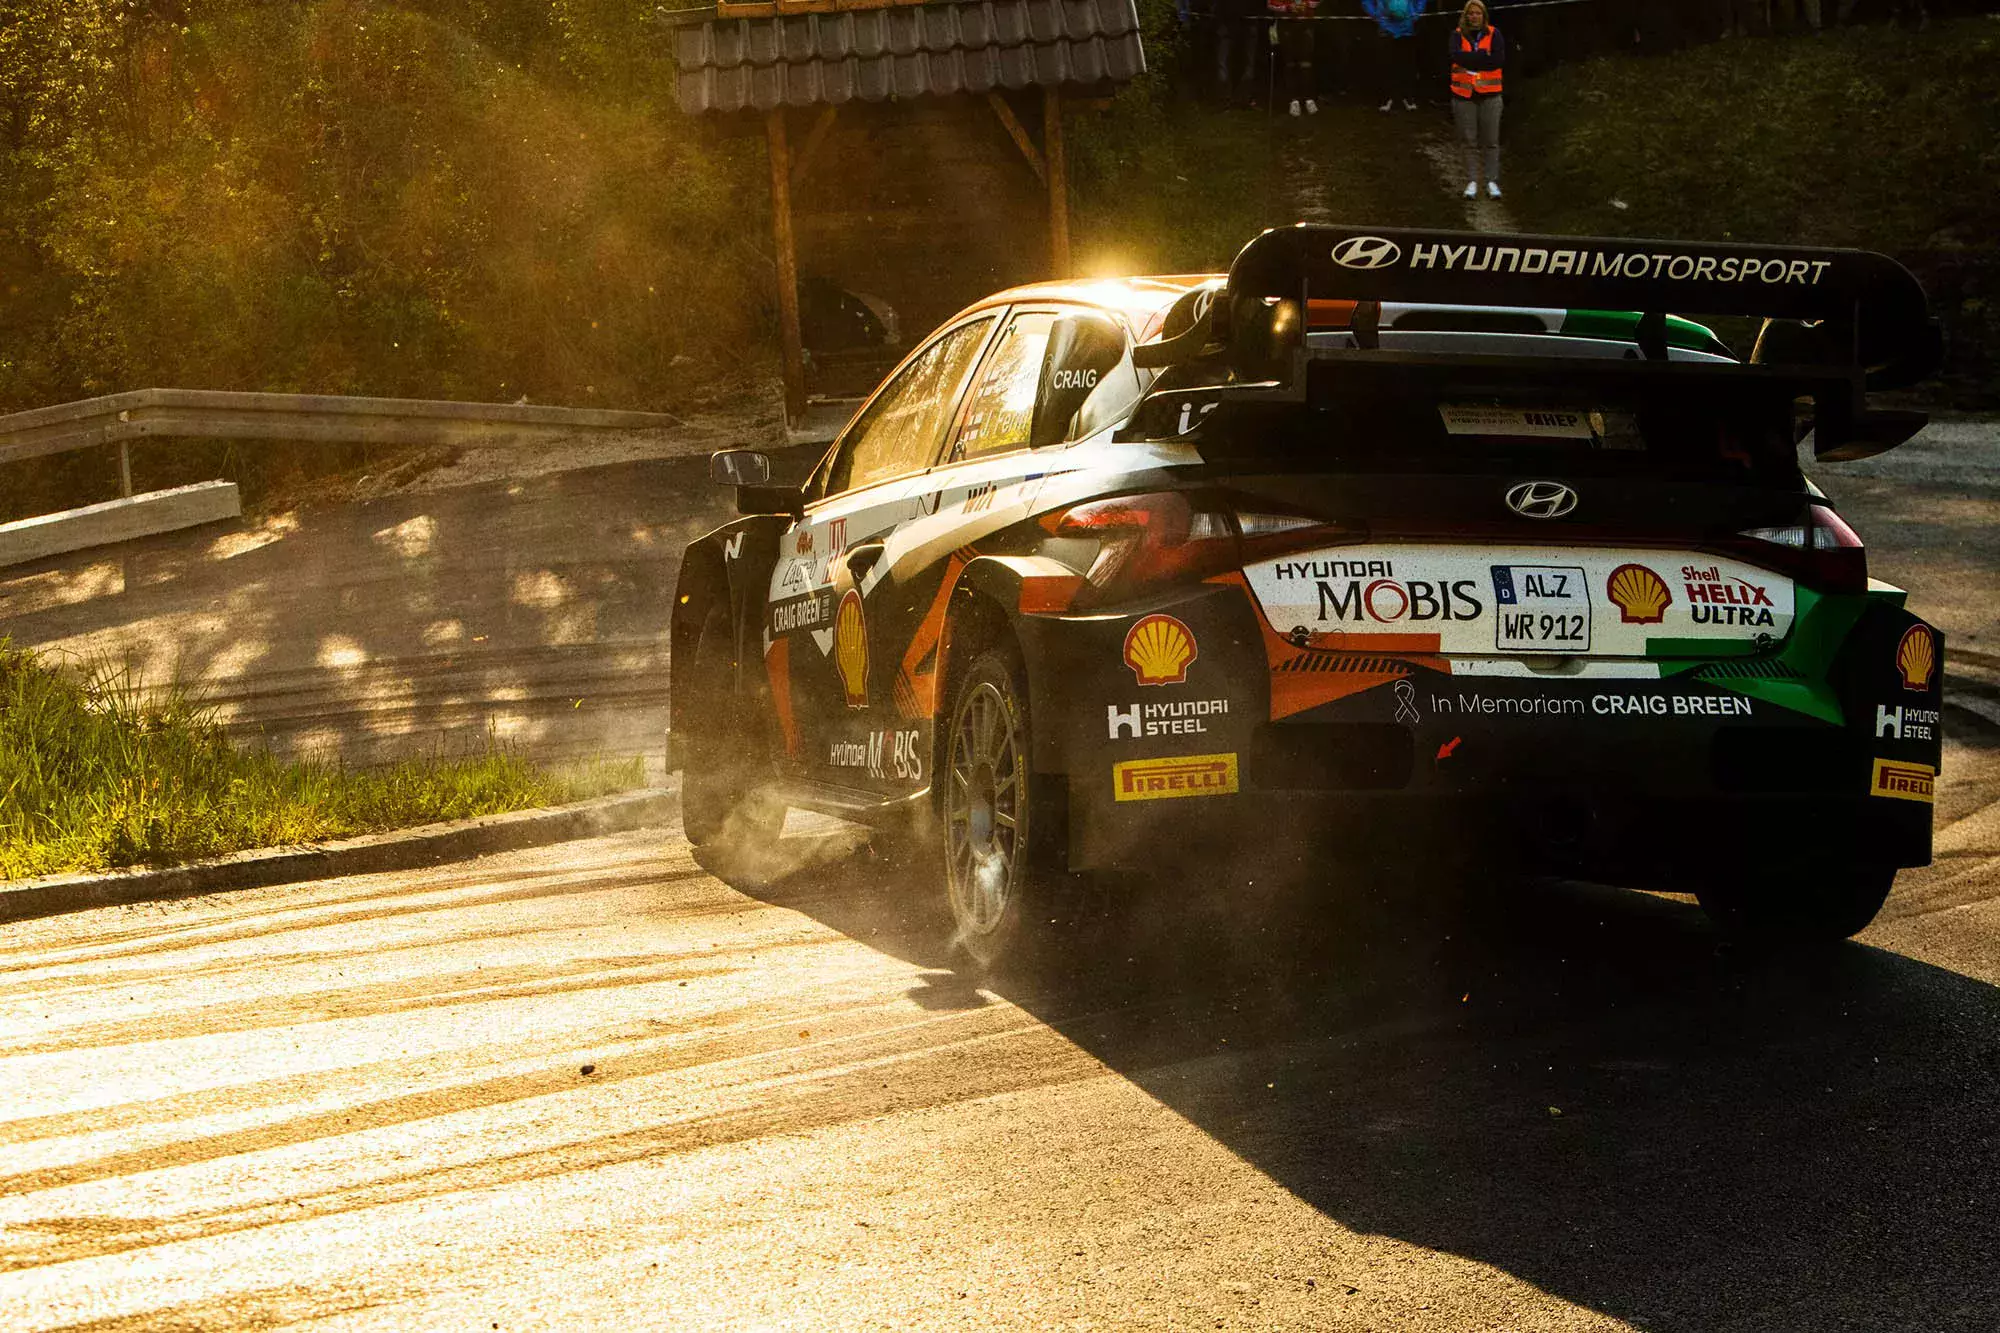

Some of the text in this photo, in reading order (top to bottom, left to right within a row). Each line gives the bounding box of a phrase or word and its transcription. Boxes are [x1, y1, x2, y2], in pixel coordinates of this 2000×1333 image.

[1409, 243, 1831, 285] HYUNDAI MOTORSPORT
[1053, 368, 1097, 390] CRAIG
[1275, 560, 1394, 580] HYUNDAI
[1680, 565, 1720, 582] Shell
[1524, 573, 1572, 599] ALZ
[1683, 577, 1775, 607] HELIX
[1315, 578, 1484, 624] MOBIS
[774, 602, 796, 633] CRAIG
[797, 598, 821, 627] BREEN
[1504, 613, 1585, 641] WR 912
[1690, 604, 1776, 627] ULTRA
[1144, 699, 1229, 719] HYUNDAI
[1430, 692, 1753, 716] In Memoriam CRAIG BREEN
[1146, 718, 1207, 736] STEEL
[1903, 724, 1932, 741] STEEL
[829, 727, 922, 781] HYUNDAI MOBIS
[1121, 761, 1228, 793] PIRELLI
